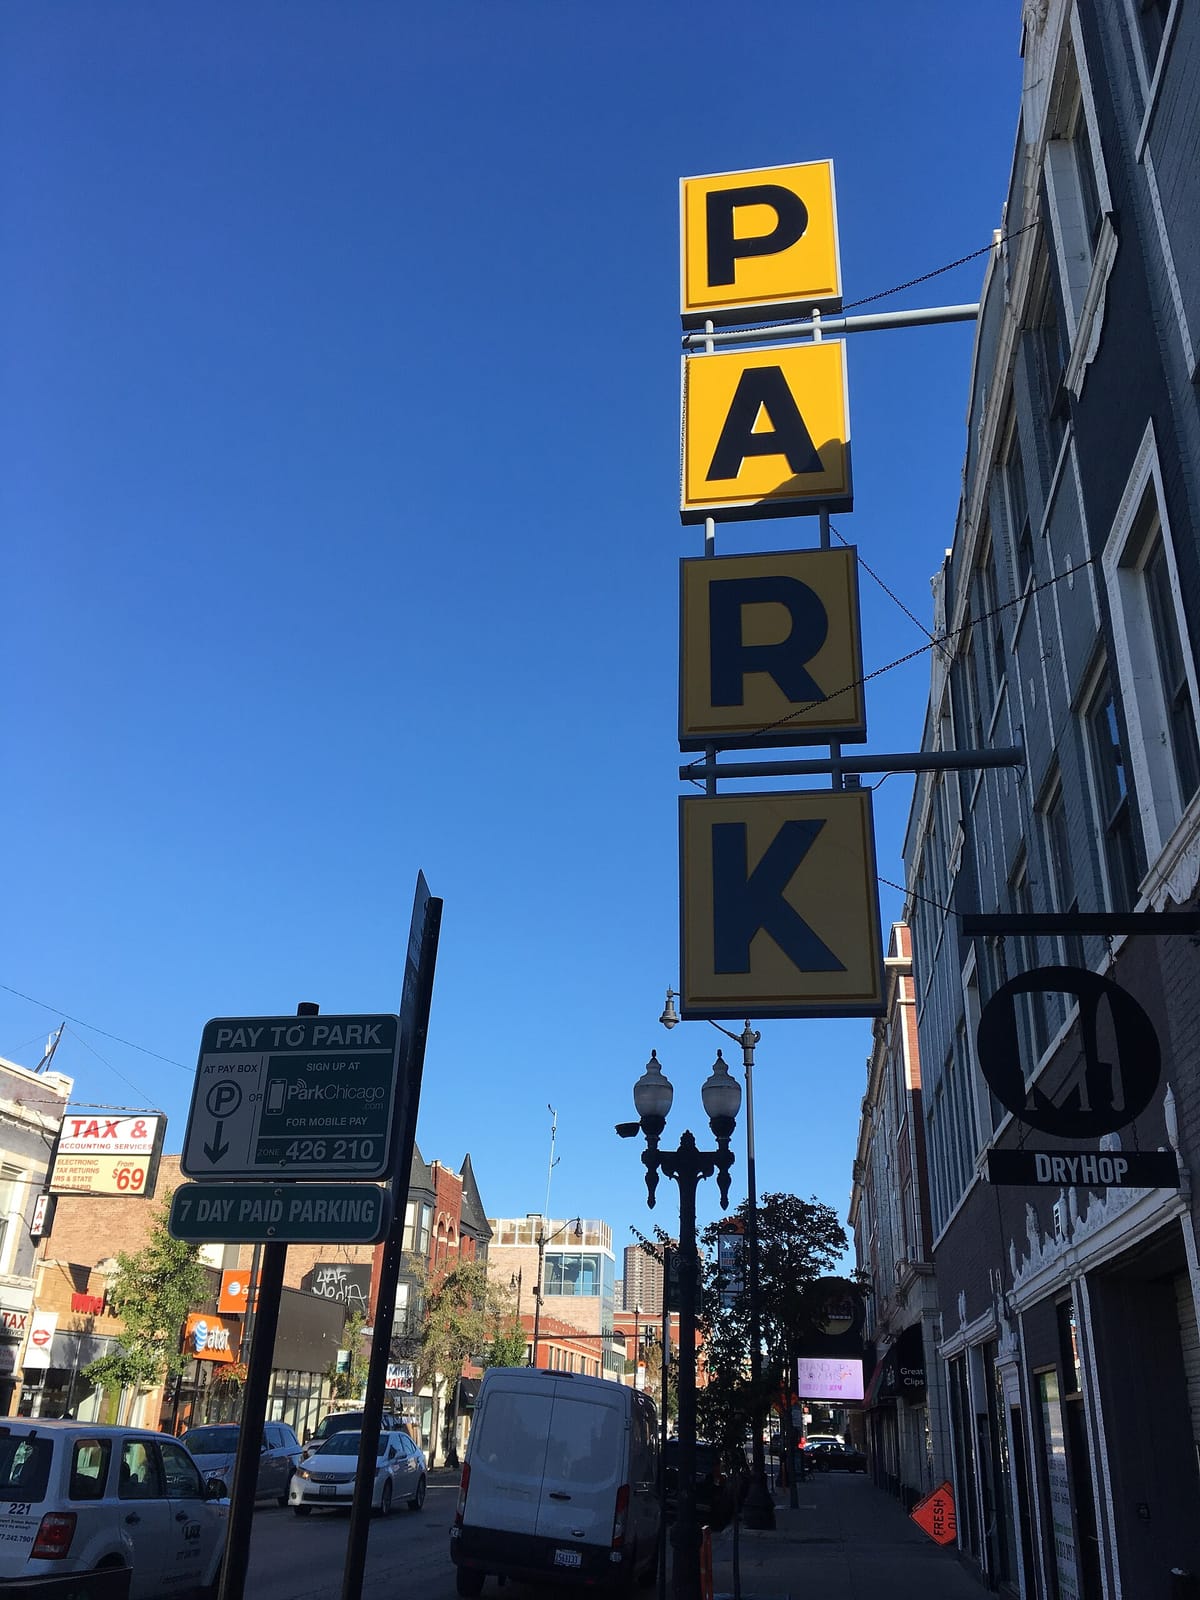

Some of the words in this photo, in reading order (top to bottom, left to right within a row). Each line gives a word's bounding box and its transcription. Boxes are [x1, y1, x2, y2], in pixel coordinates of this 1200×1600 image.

[706, 184, 848, 975] PARK
[215, 1028, 264, 1048] PAY
[271, 1026, 305, 1047] TO
[312, 1024, 383, 1046] PARK
[203, 1066, 215, 1074] AT
[217, 1065, 235, 1073] PAY
[237, 1064, 258, 1073] BOX
[306, 1063, 330, 1072] SIGN
[332, 1062, 347, 1071] UP
[347, 1062, 361, 1071] AT
[248, 1093, 263, 1102] OR
[287, 1085, 385, 1104] ParkChicago
[71, 1120, 120, 1139] TAX
[130, 1120, 148, 1139] &
[286, 1118, 306, 1126] FOR
[308, 1117, 347, 1126] MOBILE
[349, 1117, 368, 1126] PAY
[113, 1143, 153, 1151] SERVICES
[285, 1141, 327, 1160] 426
[332, 1140, 374, 1160] 210
[117, 1160, 135, 1168] From
[112, 1168, 145, 1191] $69
[33, 1199, 46, 1232] TAX
[179, 1200, 191, 1222] 7
[196, 1200, 235, 1222] DAY
[238, 1200, 283, 1222] PAID
[288, 1200, 375, 1223] PARKING
[2, 1312, 27, 1329] TAX
[900, 1367, 924, 1376] Great
[904, 1377, 924, 1387] Clips
[8, 1503, 32, 1515] 221
[933, 1499, 944, 1537] FRESH
